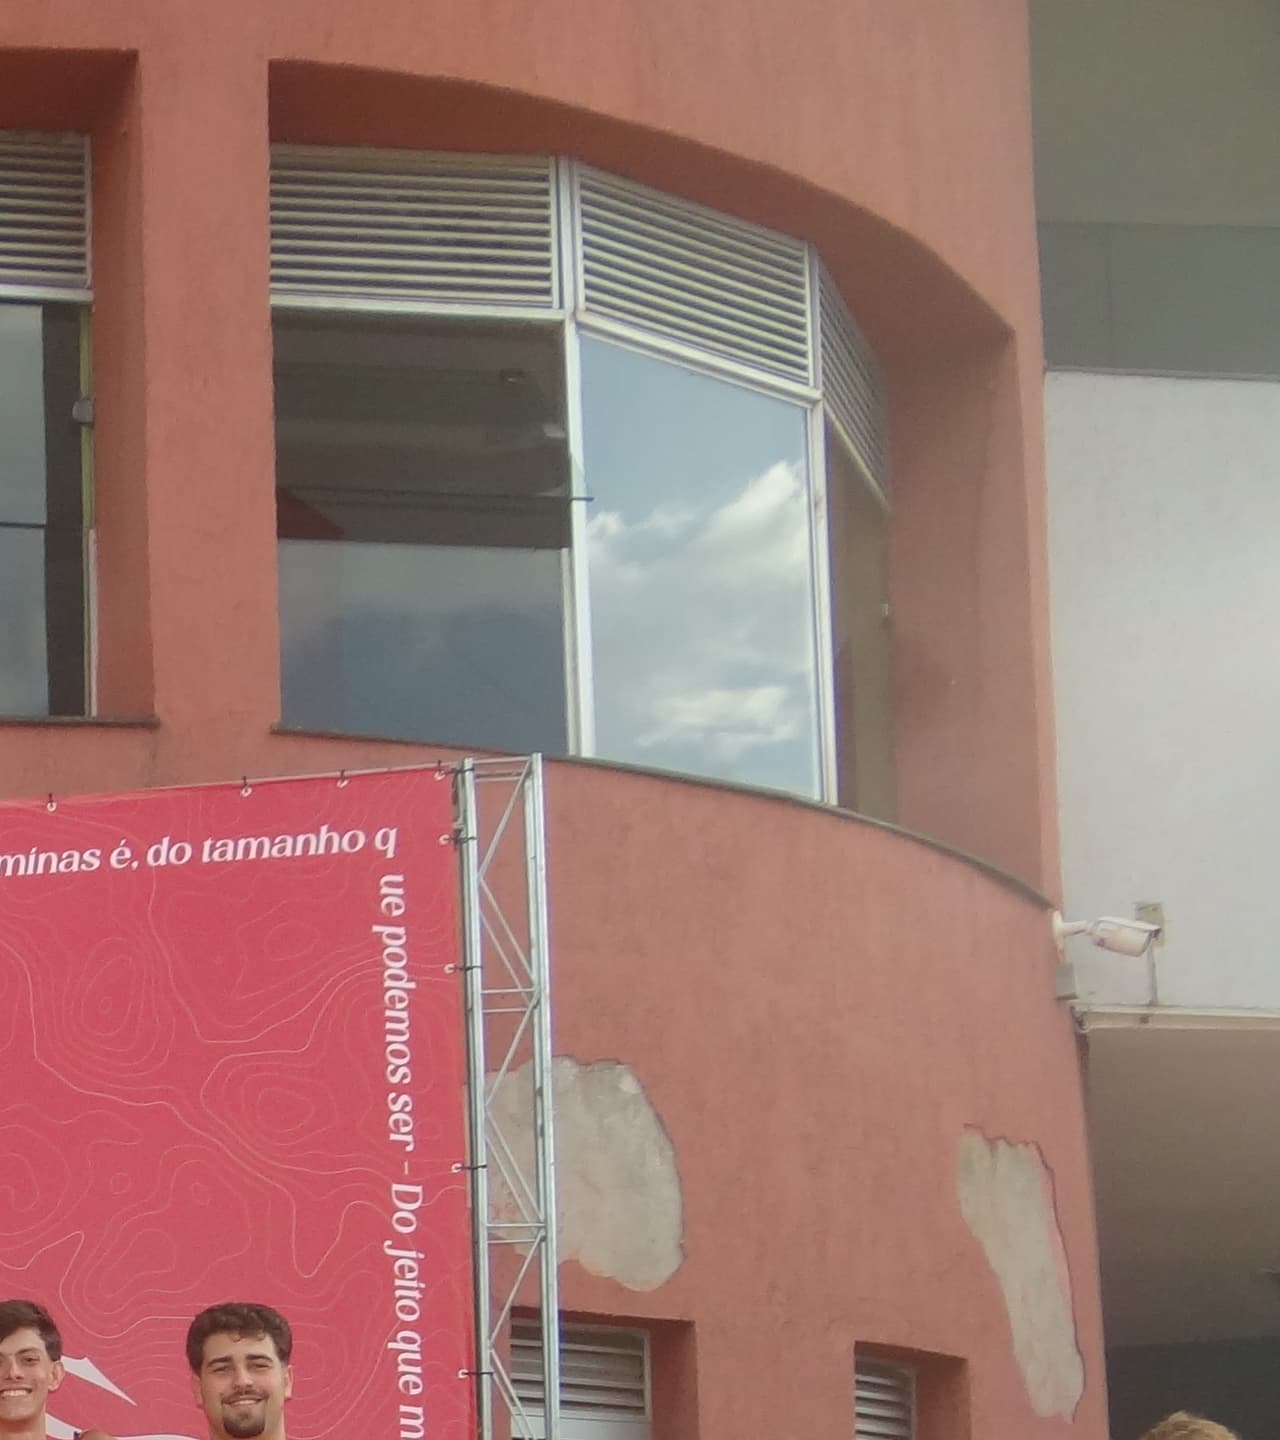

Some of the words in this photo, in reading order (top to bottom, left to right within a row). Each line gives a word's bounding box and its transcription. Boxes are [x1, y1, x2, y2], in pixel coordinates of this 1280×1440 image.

[109, 838, 139, 871] é,
[146, 835, 193, 868] do
[201, 823, 367, 864] tamanho
[374, 825, 398, 859] q
[379, 873, 406, 918] ue
[371, 924, 417, 1085] podemos
[387, 1091, 416, 1153] ser
[391, 1182, 424, 1234] Do
[383, 1239, 427, 1323] jeito
[387, 1329, 424, 1396] que
